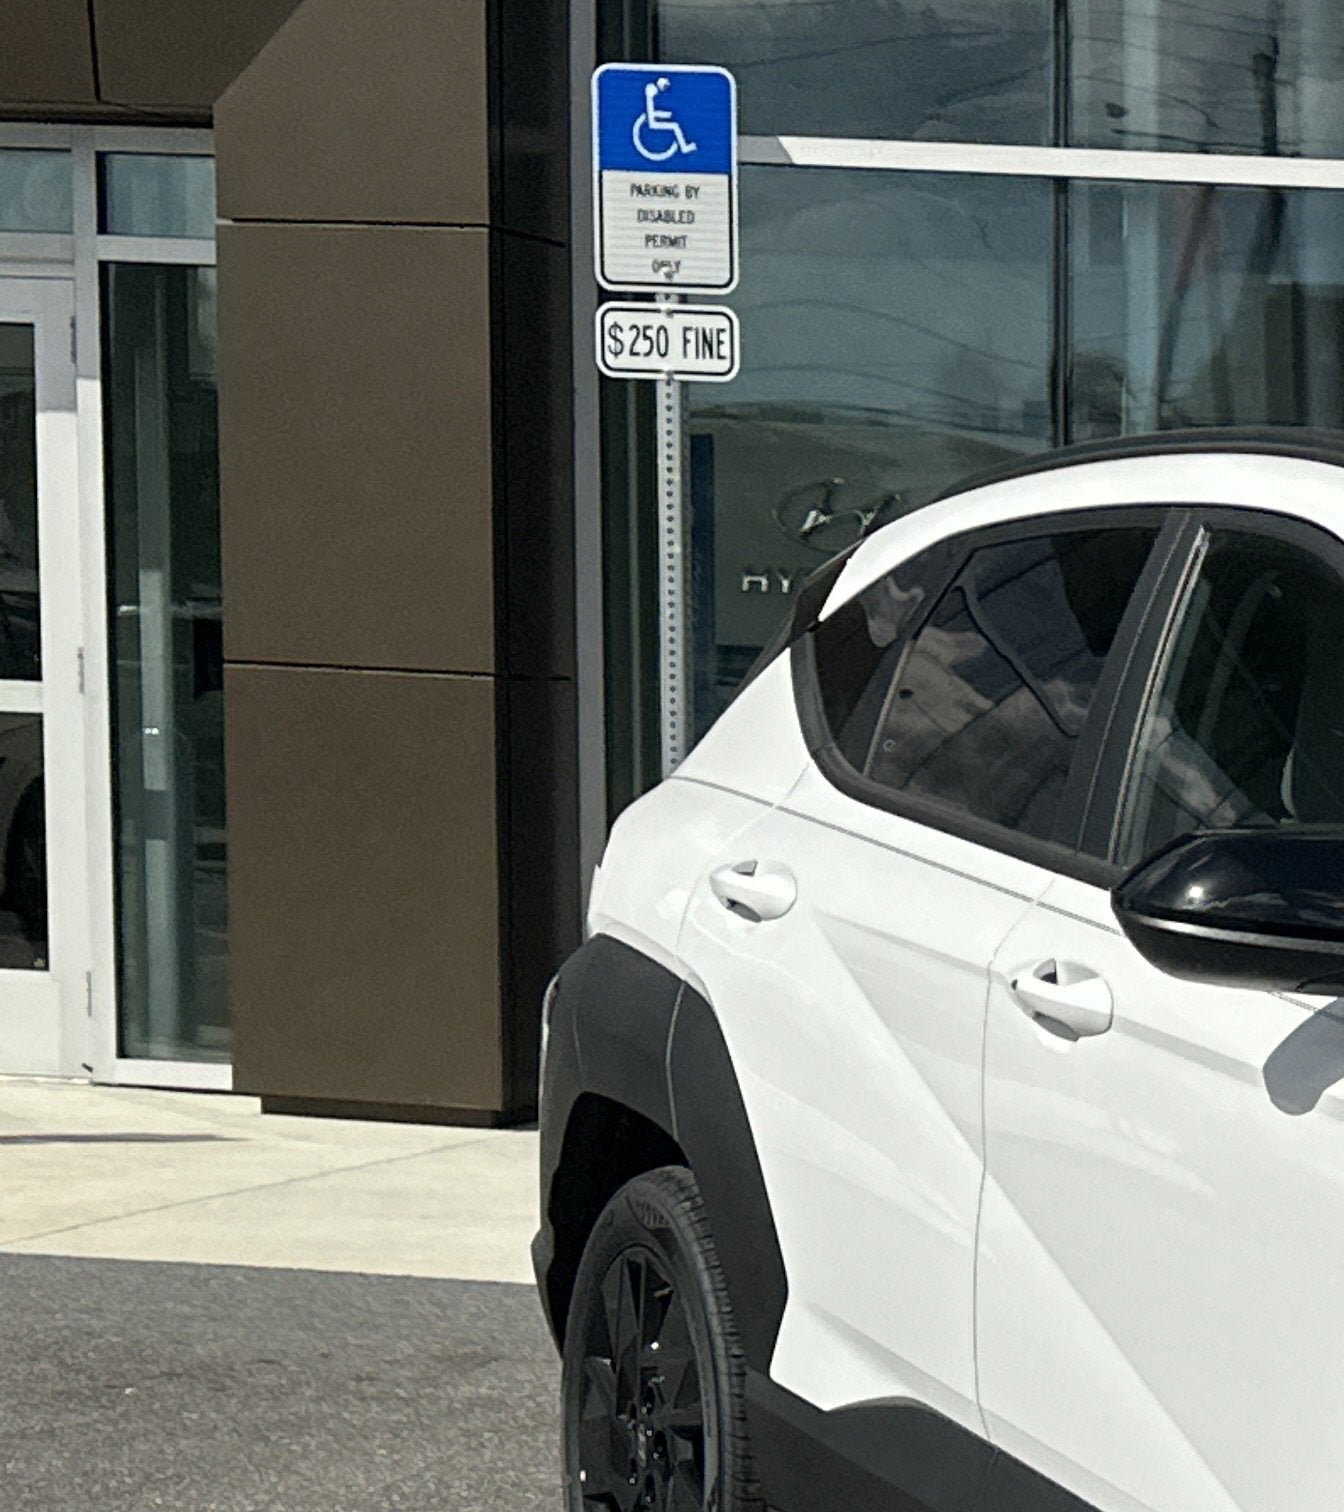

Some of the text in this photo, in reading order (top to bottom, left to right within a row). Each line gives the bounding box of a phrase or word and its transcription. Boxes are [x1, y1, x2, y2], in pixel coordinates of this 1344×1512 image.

[630, 183, 700, 199] PARKING BY
[637, 209, 695, 225] DISABLED
[645, 234, 688, 249] PERMIT
[607, 321, 728, 360] $250 FINE
